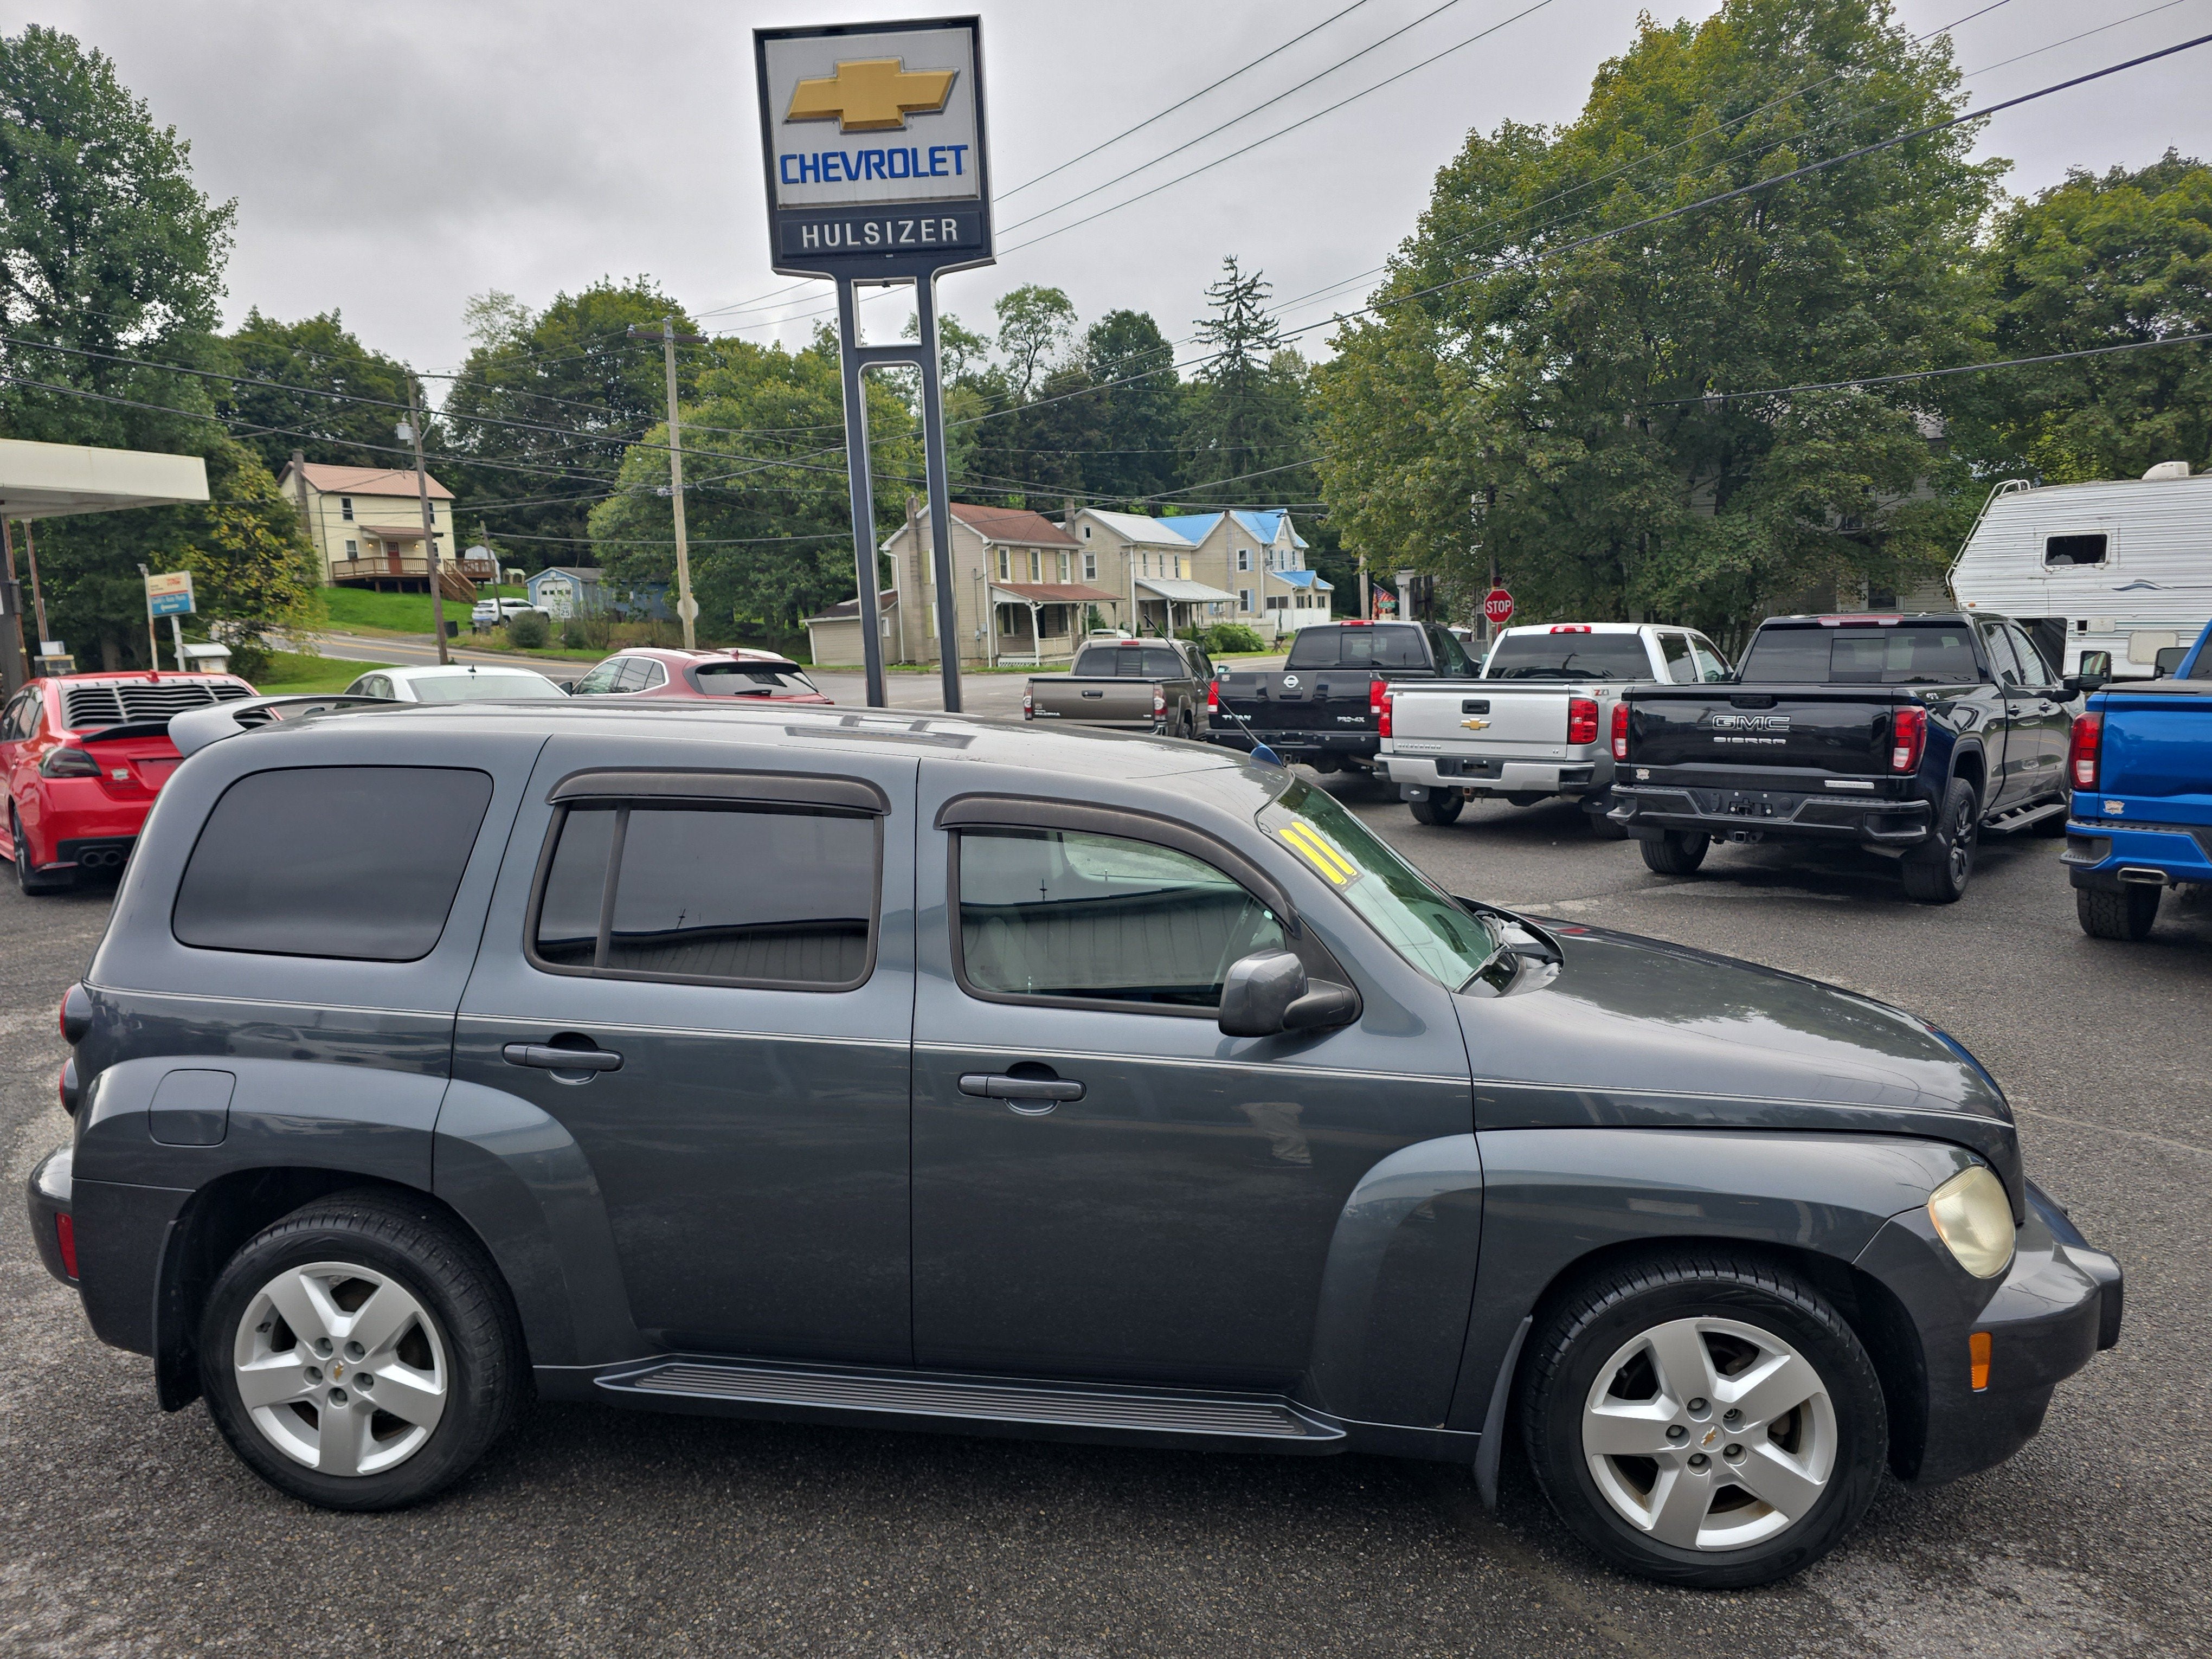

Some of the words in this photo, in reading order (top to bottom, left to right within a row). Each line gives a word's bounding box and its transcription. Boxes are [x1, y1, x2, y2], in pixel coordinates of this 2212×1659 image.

[780, 144, 968, 184] CHEVROLET
[802, 218, 958, 249] HULSIZER
[1486, 600, 1512, 614] STOP
[1712, 715, 1791, 732] GMC
[1713, 736, 1787, 745] SIERRA
[1279, 821, 1358, 885] 11
